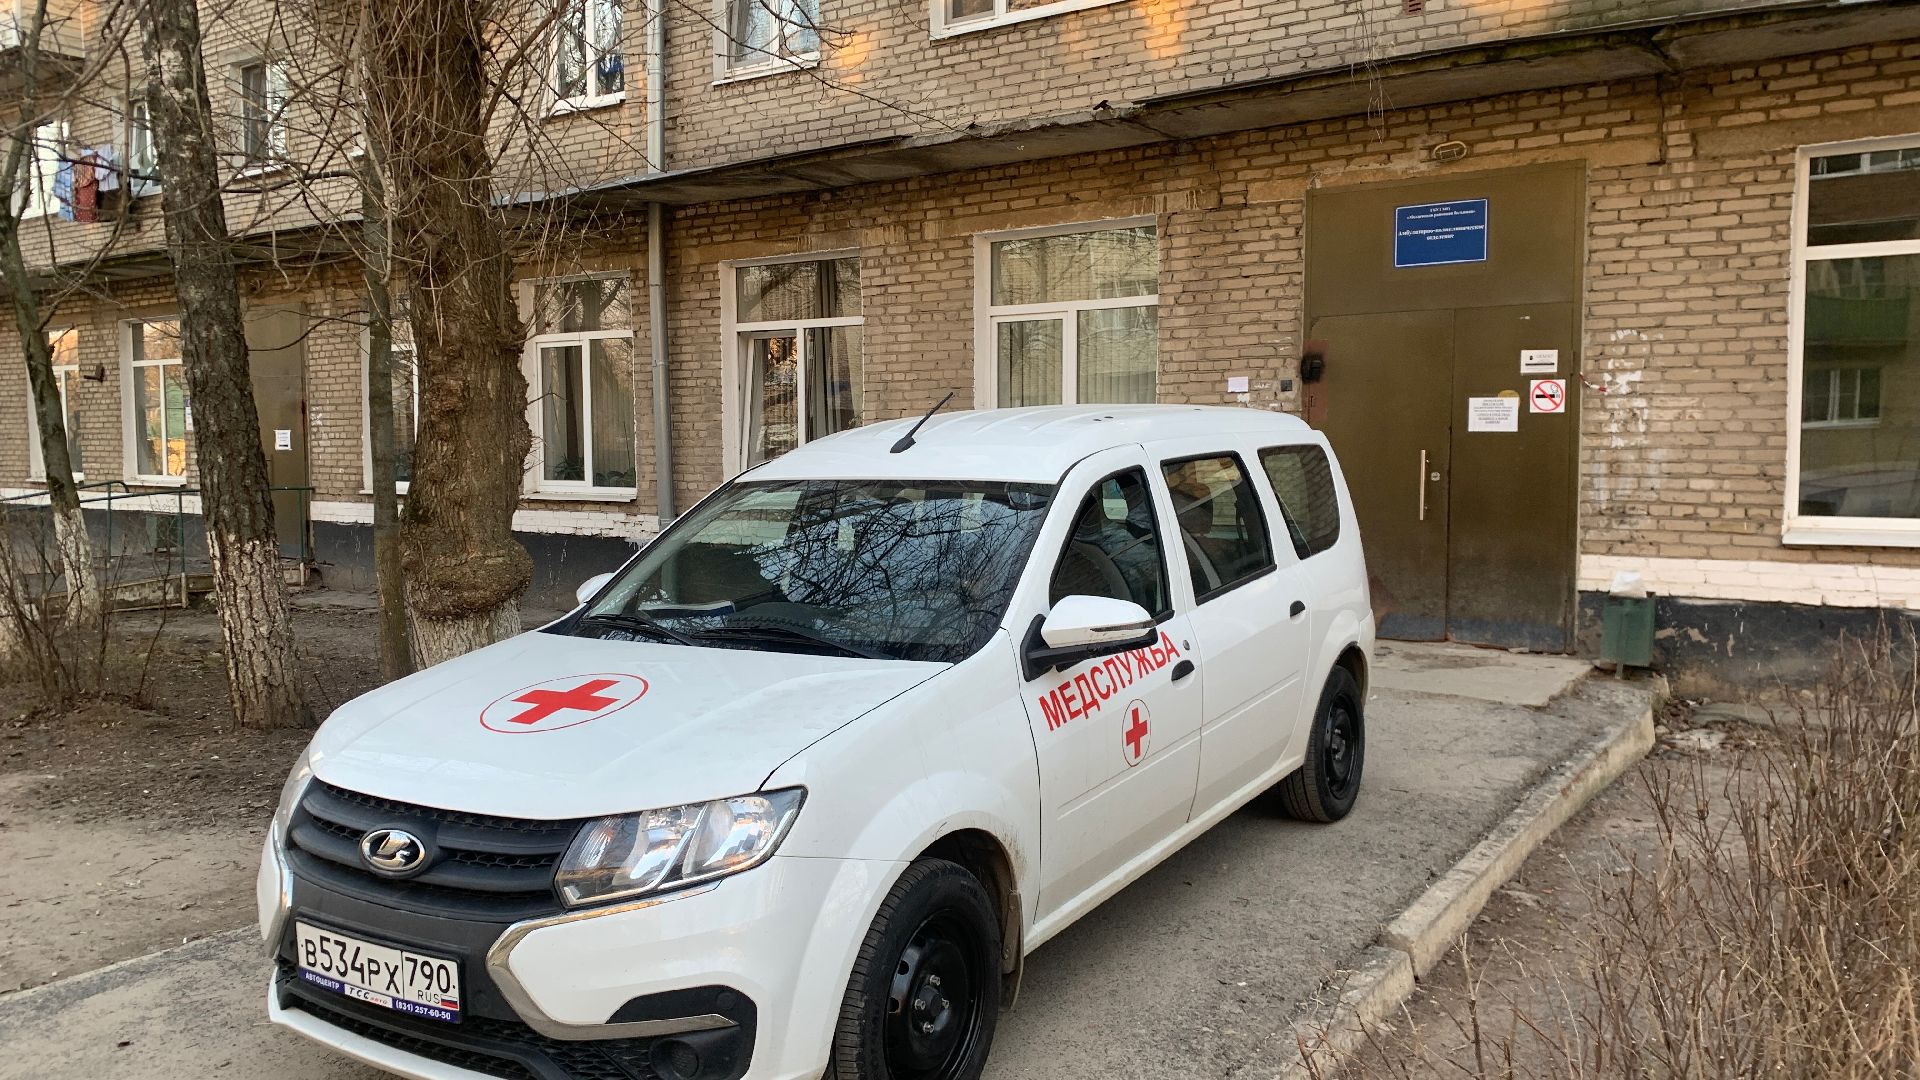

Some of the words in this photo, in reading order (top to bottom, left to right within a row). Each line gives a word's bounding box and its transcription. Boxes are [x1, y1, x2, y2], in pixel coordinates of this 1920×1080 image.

[1038, 631, 1181, 731] МЕДСЛУЖБА
[305, 971, 340, 990] АВТОЦЕНТР
[396, 1000, 413, 1012] (831)
[414, 1005, 451, 1020] 257-60-50
[405, 956, 451, 994] 790
[417, 989, 440, 1004] RUS
